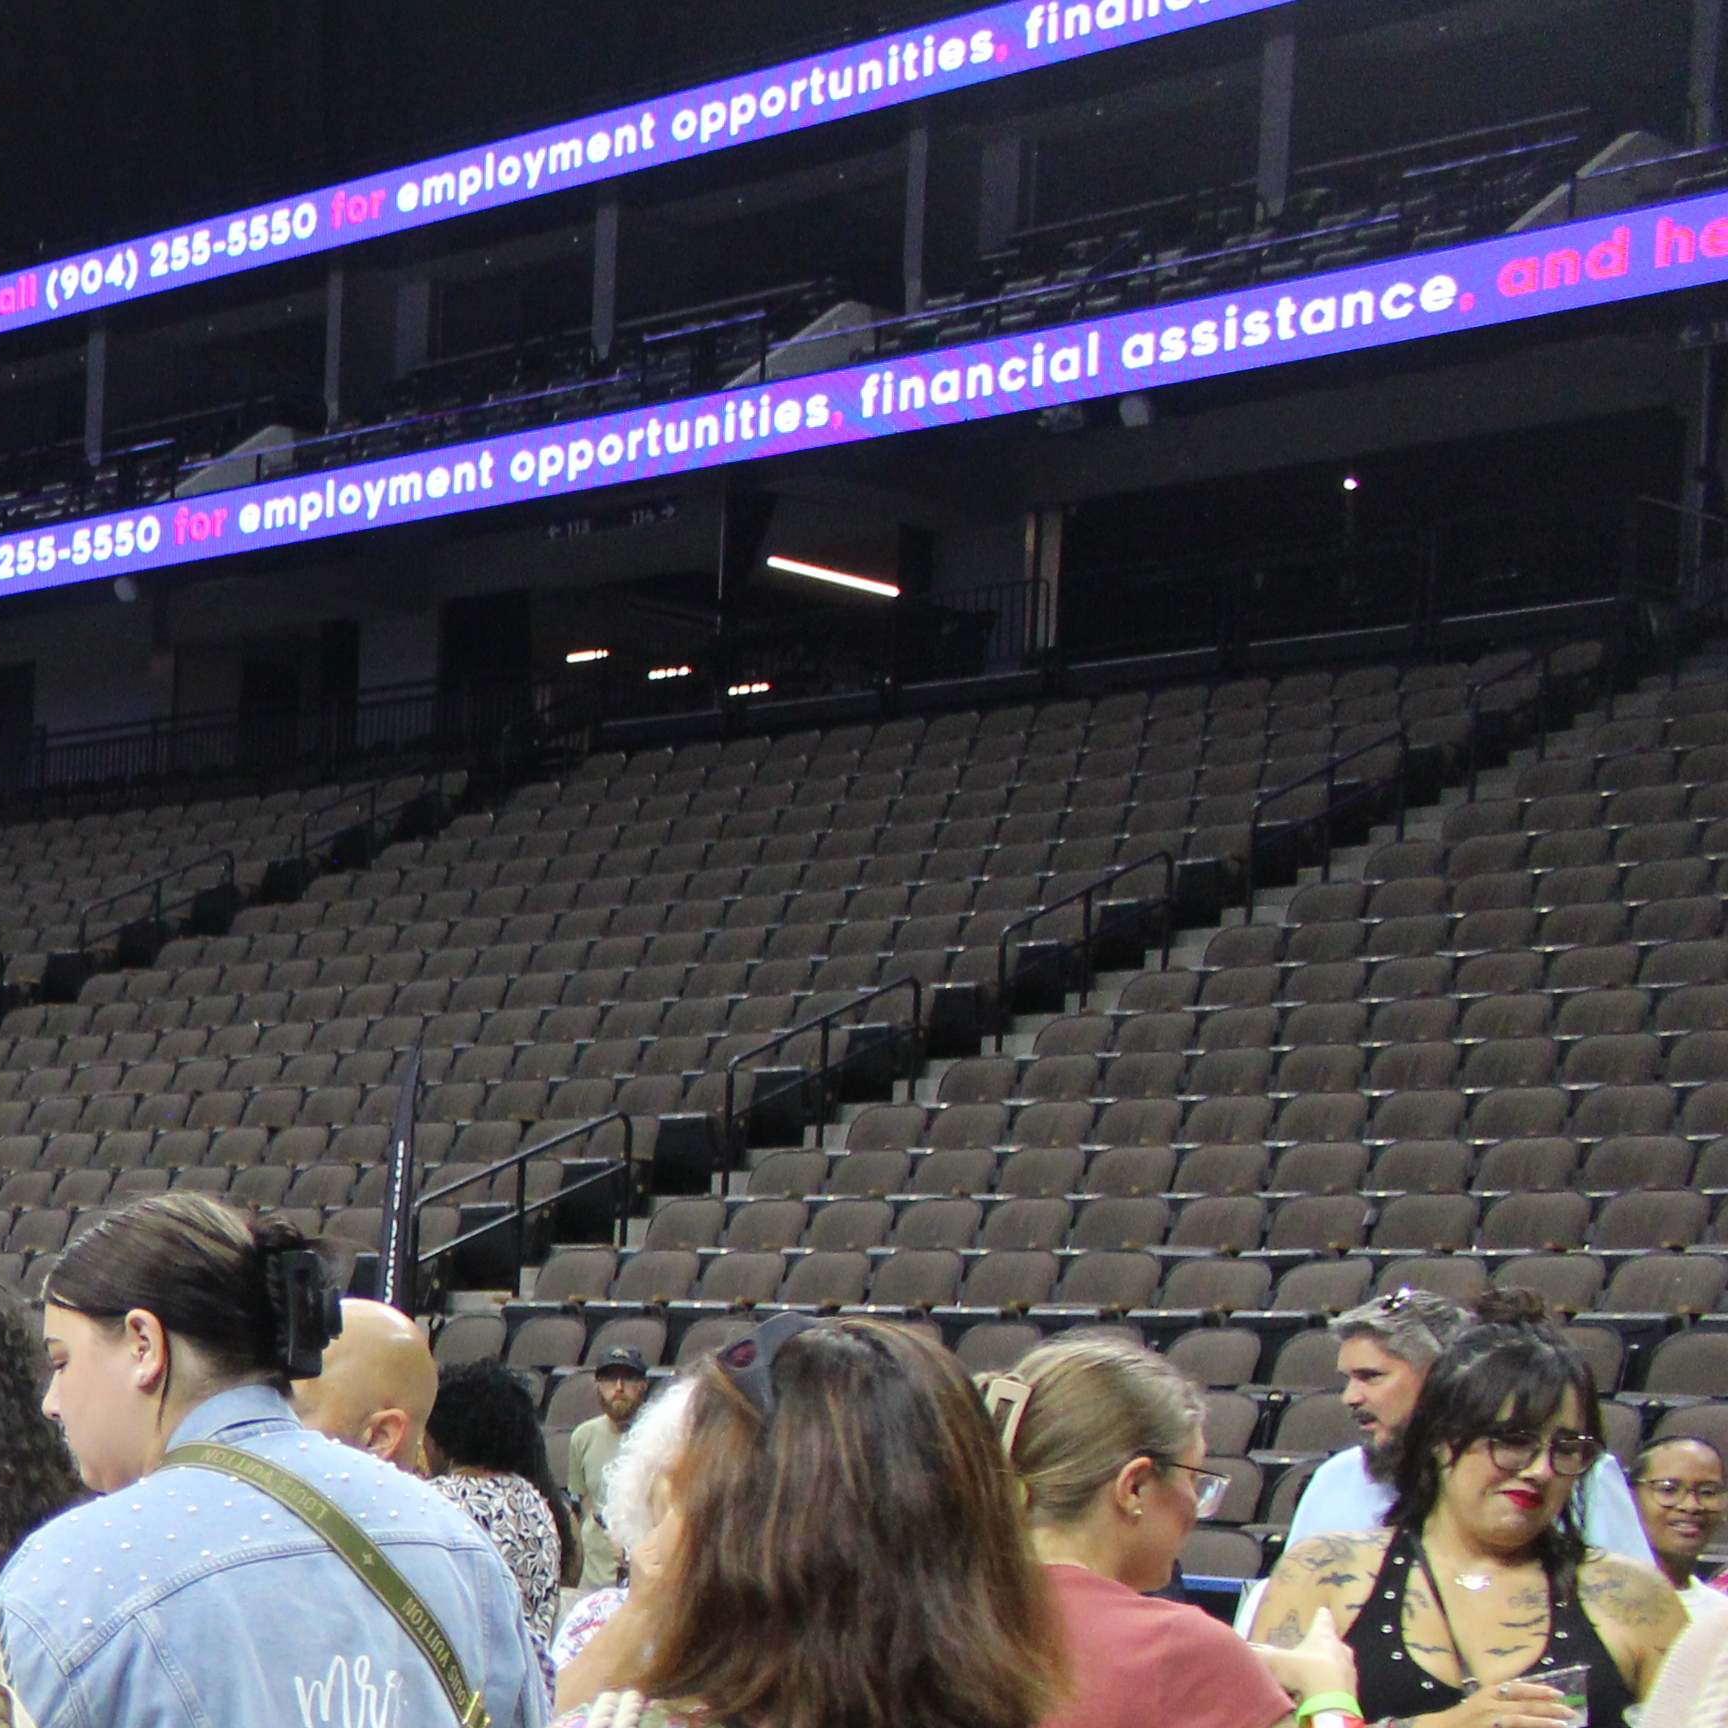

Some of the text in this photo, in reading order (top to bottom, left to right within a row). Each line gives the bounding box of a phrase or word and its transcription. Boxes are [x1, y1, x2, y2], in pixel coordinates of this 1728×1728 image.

[44, 249, 138, 310] (904)
[148, 203, 318, 280] 255-5550
[329, 192, 387, 231] for
[396, 112, 659, 214] employment
[173, 506, 228, 546] for
[238, 451, 494, 536] employment
[859, 331, 1100, 418] financial
[1497, 226, 1631, 300] and
